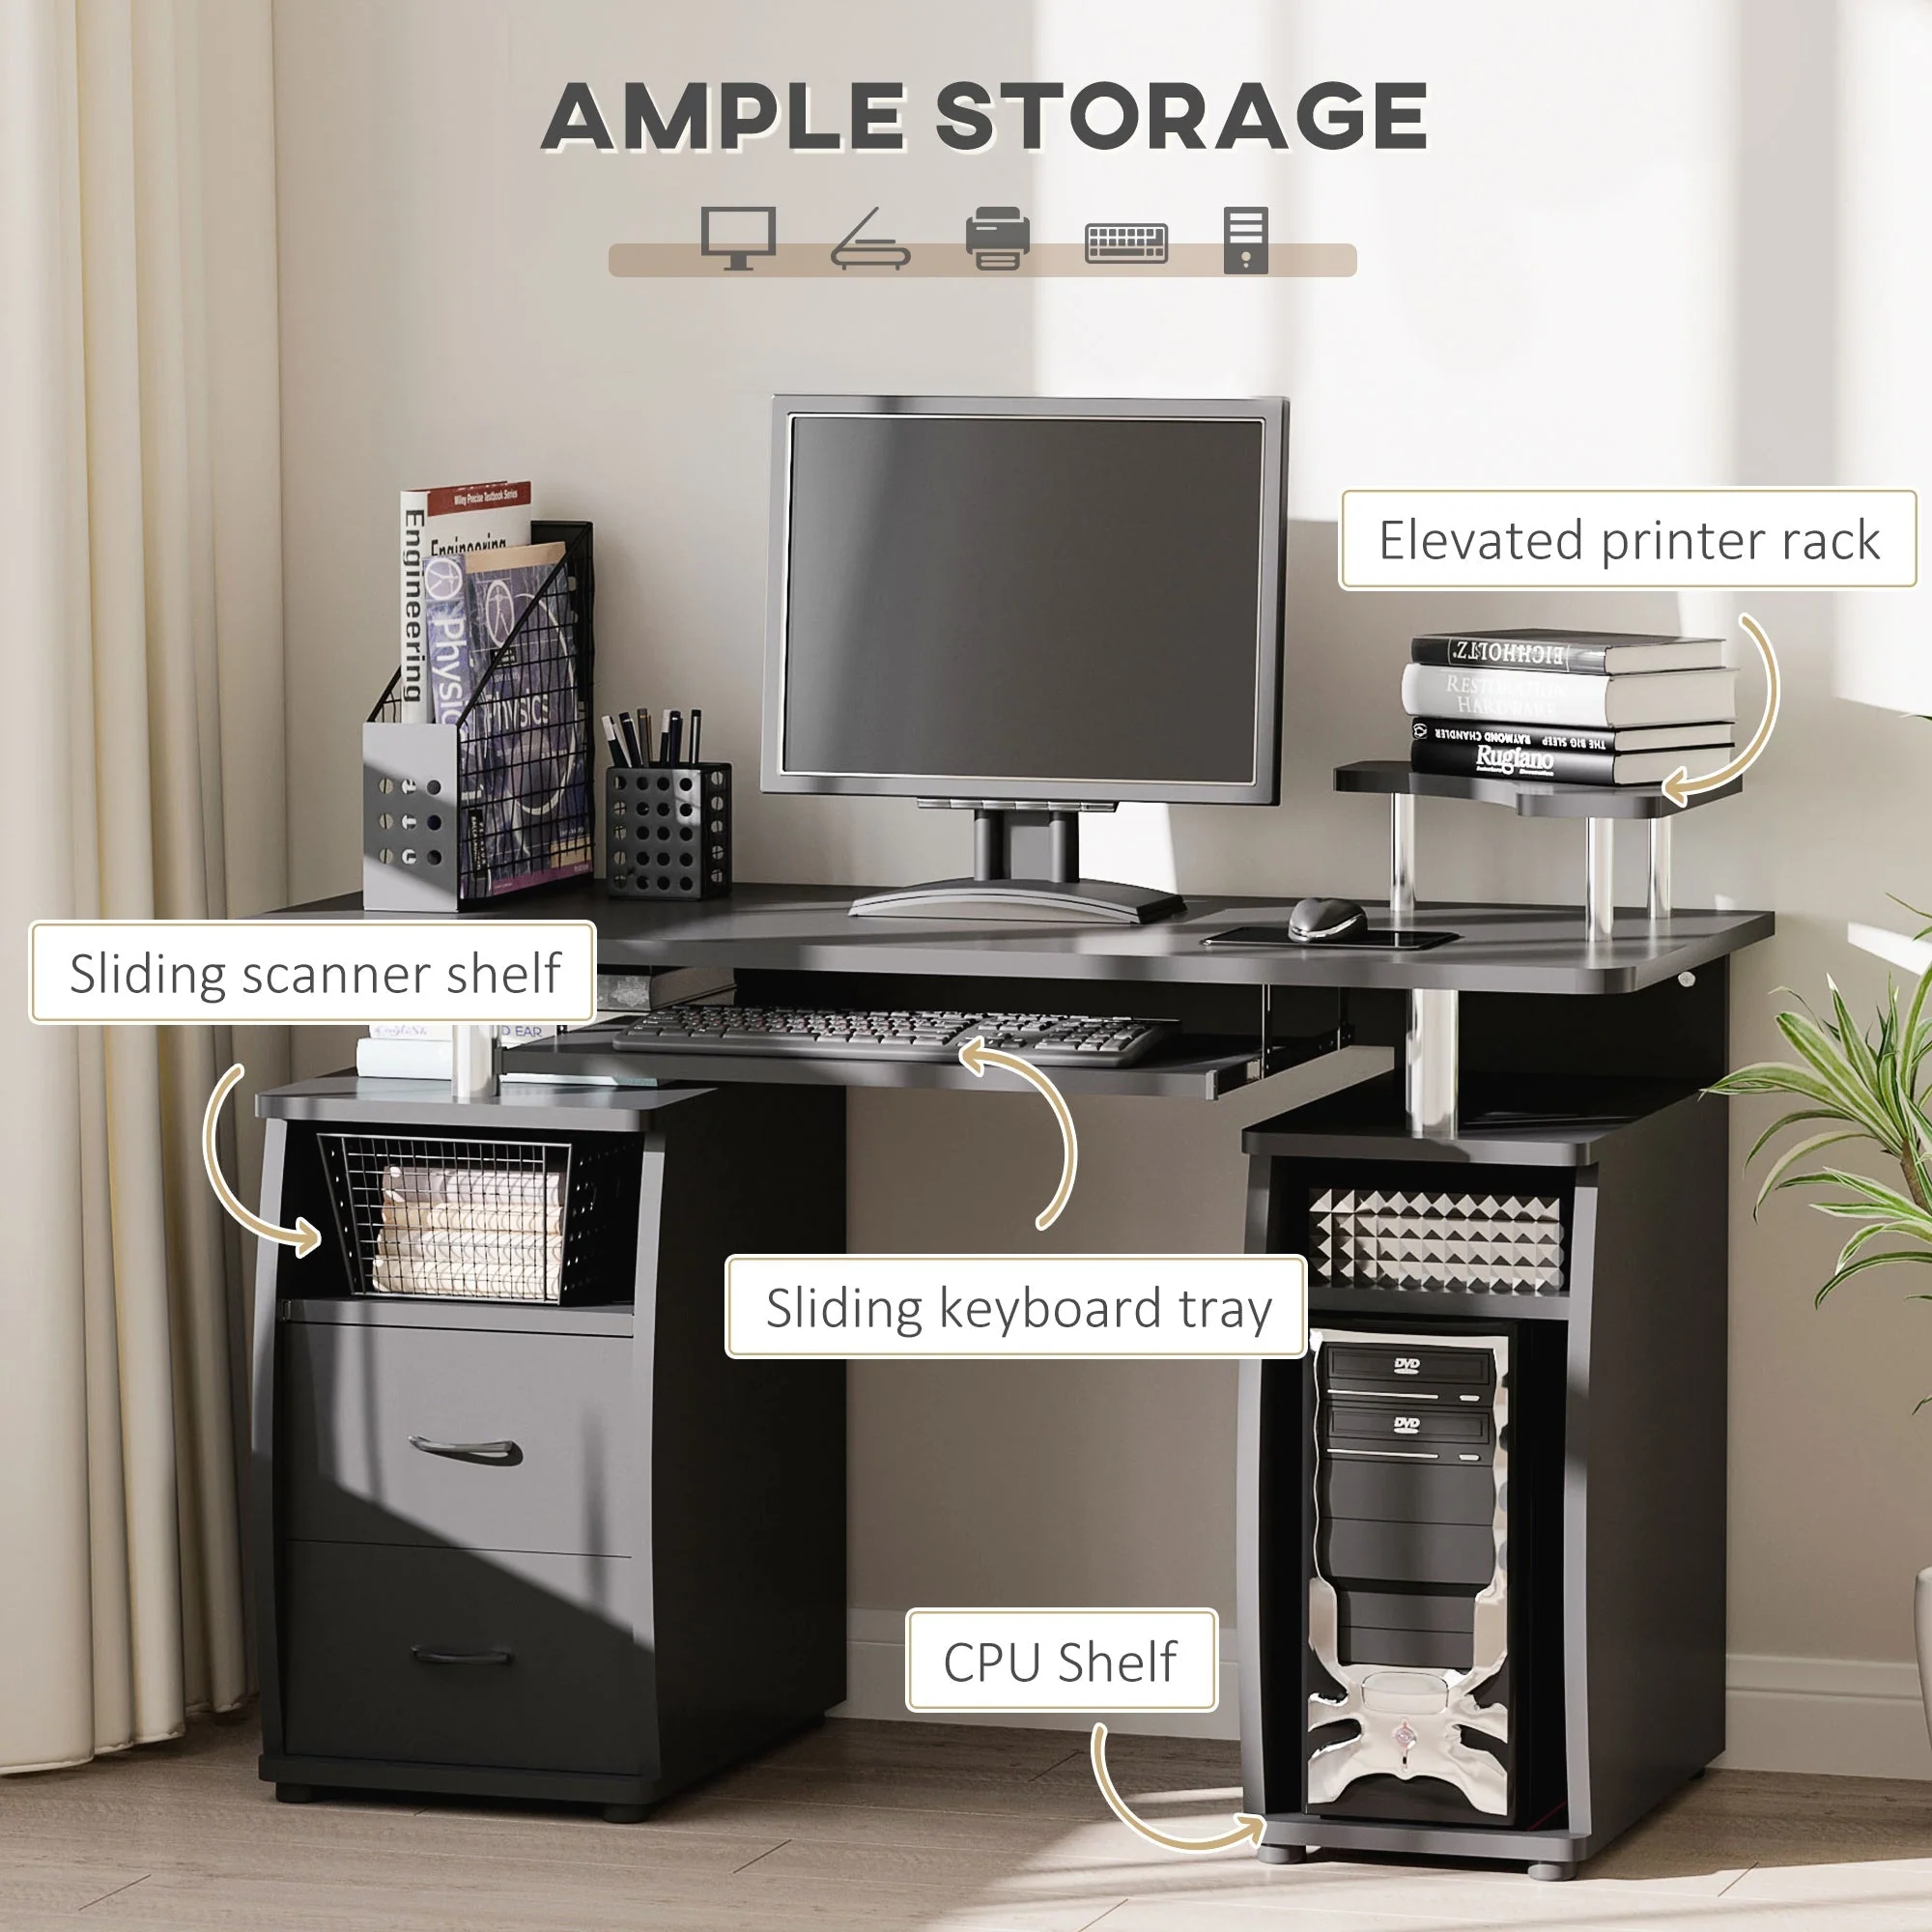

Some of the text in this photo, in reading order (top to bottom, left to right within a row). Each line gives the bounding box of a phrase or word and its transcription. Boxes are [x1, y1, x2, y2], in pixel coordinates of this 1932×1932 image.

[503, 489, 519, 499] Series
[403, 509, 425, 703] Engineering
[1435, 728, 1532, 745] RAYMOND CHANDLER
[1542, 736, 1606, 751] THE BIG SLEEP
[515, 1026, 543, 1037] EAR
[1394, 1357, 1421, 1372] DVD
[1394, 1416, 1421, 1431] DVD
